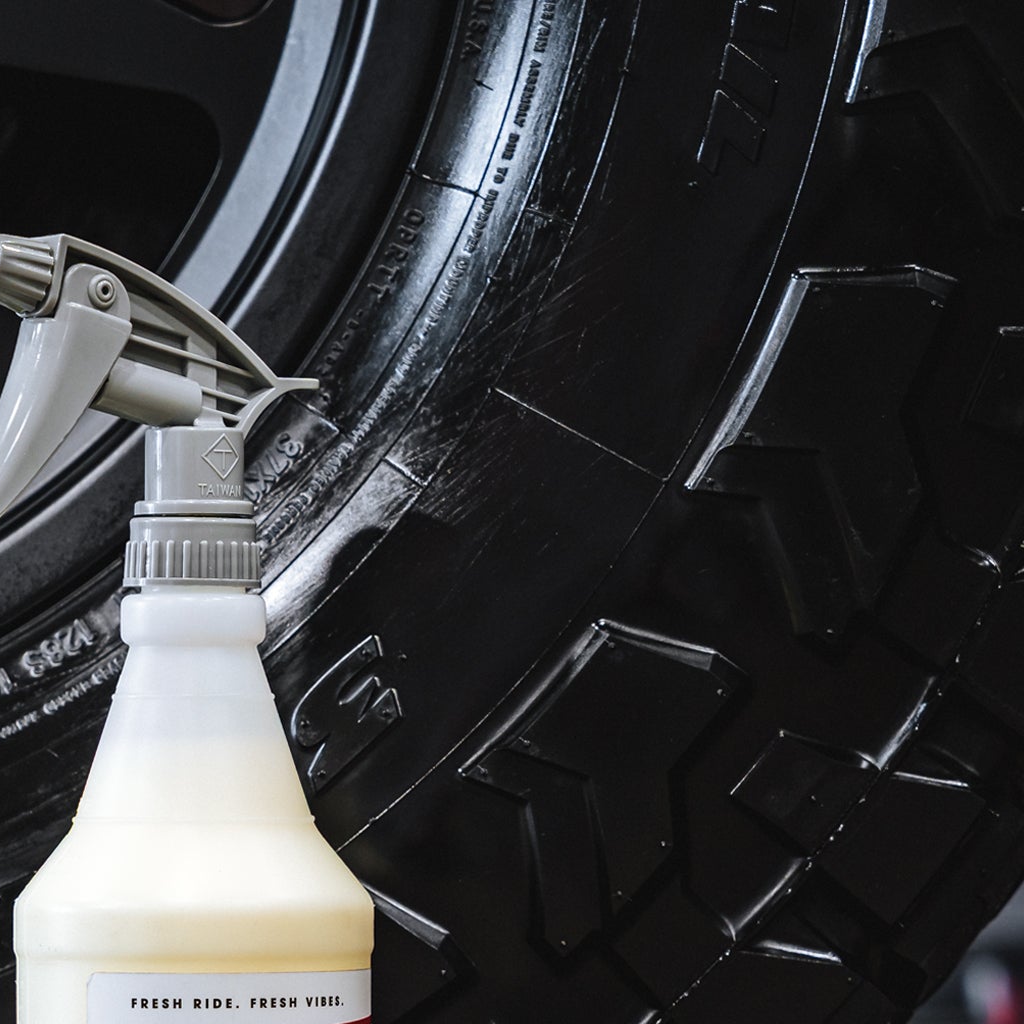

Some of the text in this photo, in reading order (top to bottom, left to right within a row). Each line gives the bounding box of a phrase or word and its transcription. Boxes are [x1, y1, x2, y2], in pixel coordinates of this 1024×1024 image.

[492, 165, 508, 185] TO
[198, 483, 242, 497] TAIWAN
[131, 996, 345, 1010] FRESH RIDE. FRESH VIBES.
